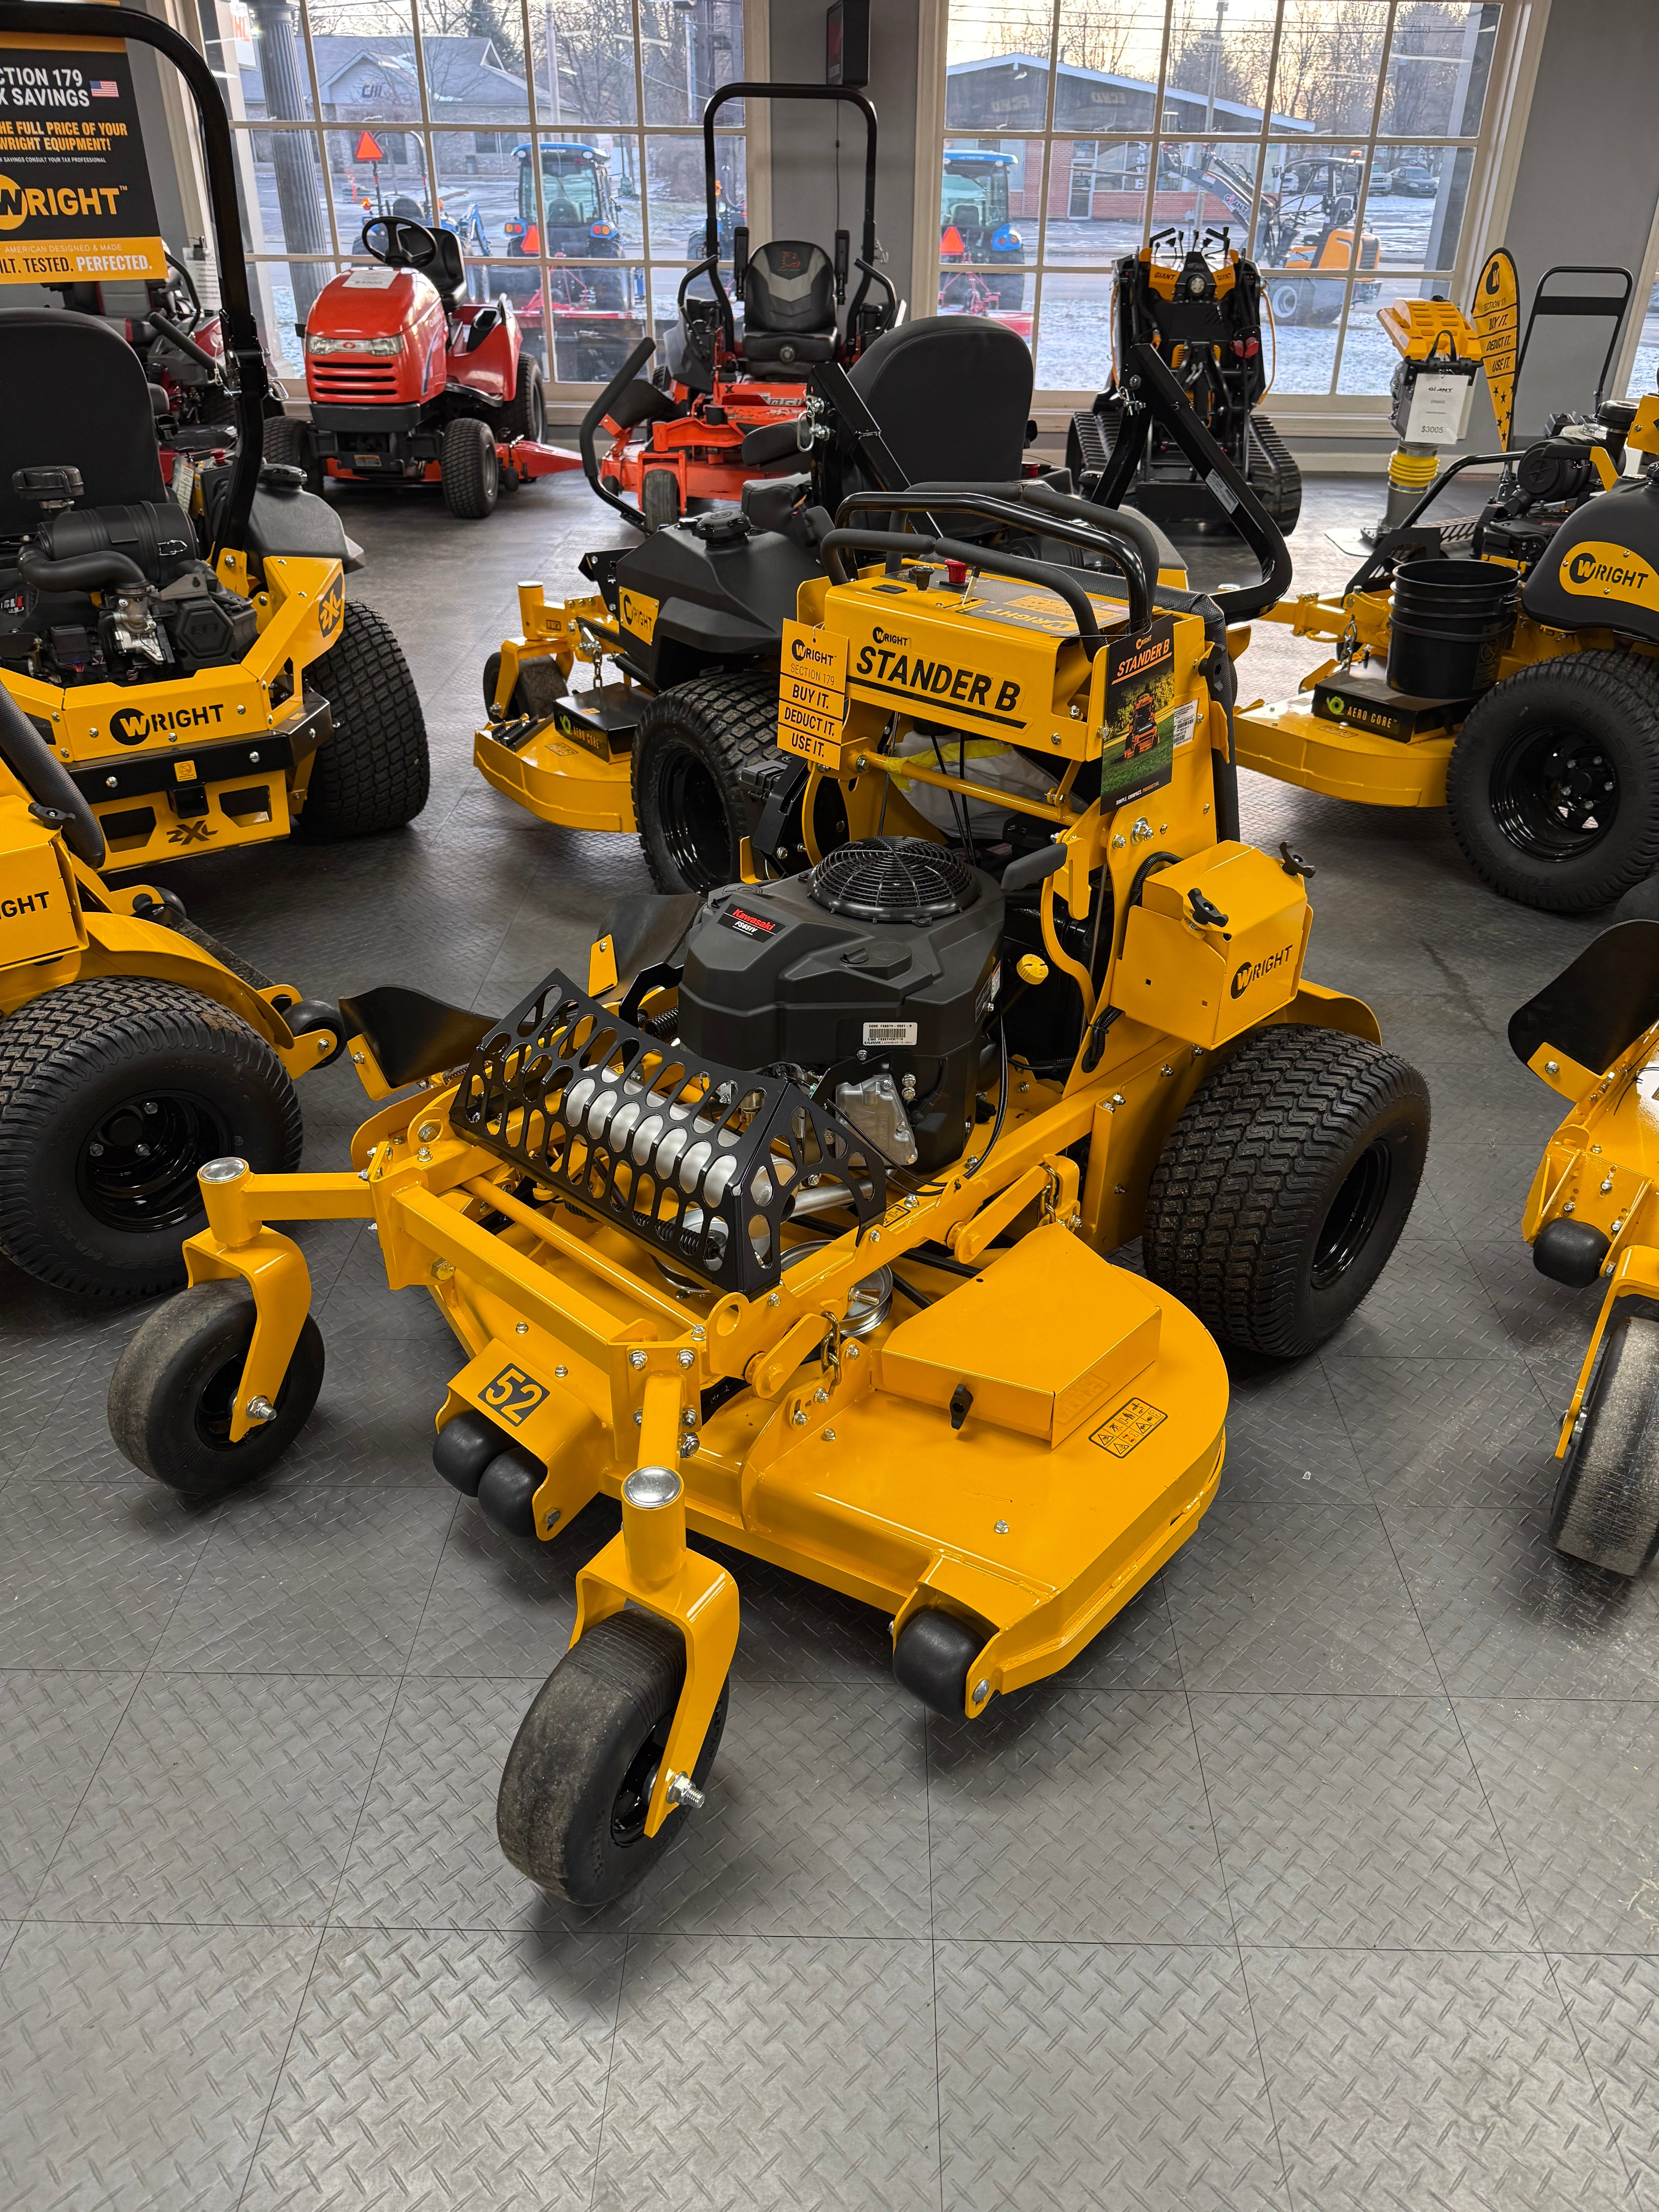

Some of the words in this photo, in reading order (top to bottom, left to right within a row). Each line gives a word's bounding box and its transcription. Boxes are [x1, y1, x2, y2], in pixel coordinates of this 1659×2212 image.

[0, 67, 49, 86] TION
[52, 69, 83, 87] 179
[11, 88, 90, 107] SAVINGS
[15, 122, 45, 135] FULL
[46, 122, 80, 136] PRICE
[81, 122, 96, 136] OF
[97, 123, 128, 136] YOUR
[23, 257, 74, 273] TESTED.
[76, 255, 153, 271] PERFECTED.
[1154, 272, 1176, 280] GIANT
[1498, 314, 1508, 326] IT.
[1492, 359, 1504, 372] USE
[1421, 425, 1444, 433] $3005
[1573, 556, 1649, 589] WRIGHT
[624, 598, 652, 632] WRIGHT
[874, 628, 908, 646] WRIGHT
[793, 641, 834, 666] WRIGHT
[1117, 643, 1163, 677] STANDER
[1163, 639, 1170, 655] B
[791, 663, 821, 681] SECTION
[823, 674, 835, 685] 179
[857, 646, 992, 706] STANDER
[994, 680, 1021, 712] B
[792, 684, 815, 704] BUY
[817, 692, 829, 709] IT.
[114, 704, 223, 741] WRIGHT
[784, 706, 823, 731] DEDUCT
[824, 720, 835, 736] IT.
[1347, 706, 1367, 720] AERO
[792, 732, 812, 752] USE
[813, 740, 824, 757] IT.
[0, 891, 50, 920] GHT
[733, 909, 776, 931] Kawasaki
[734, 921, 758, 933] FS651V
[1234, 944, 1293, 995] WRIGHT
[486, 1368, 542, 1424] 52
